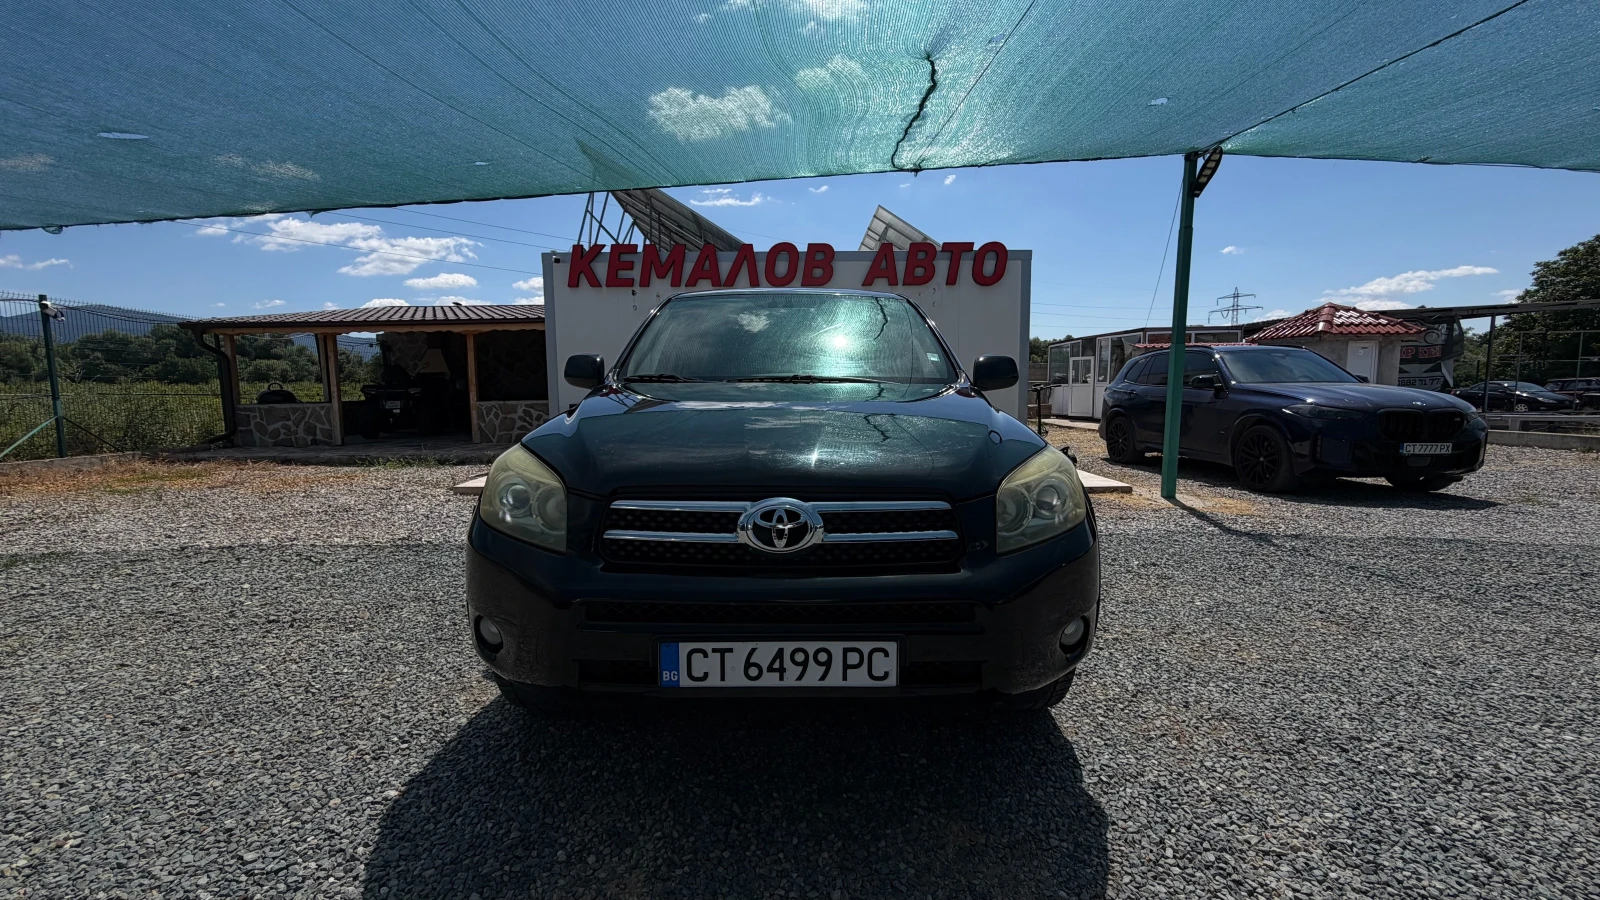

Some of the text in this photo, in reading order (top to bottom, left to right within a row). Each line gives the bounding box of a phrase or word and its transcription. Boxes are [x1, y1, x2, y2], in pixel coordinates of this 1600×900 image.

[567, 241, 1009, 288] КЕМАЛОВ АВТО
[1418, 444, 1439, 453] 7777
[686, 647, 890, 682] CT 6499 PC
[663, 671, 679, 682] BG
